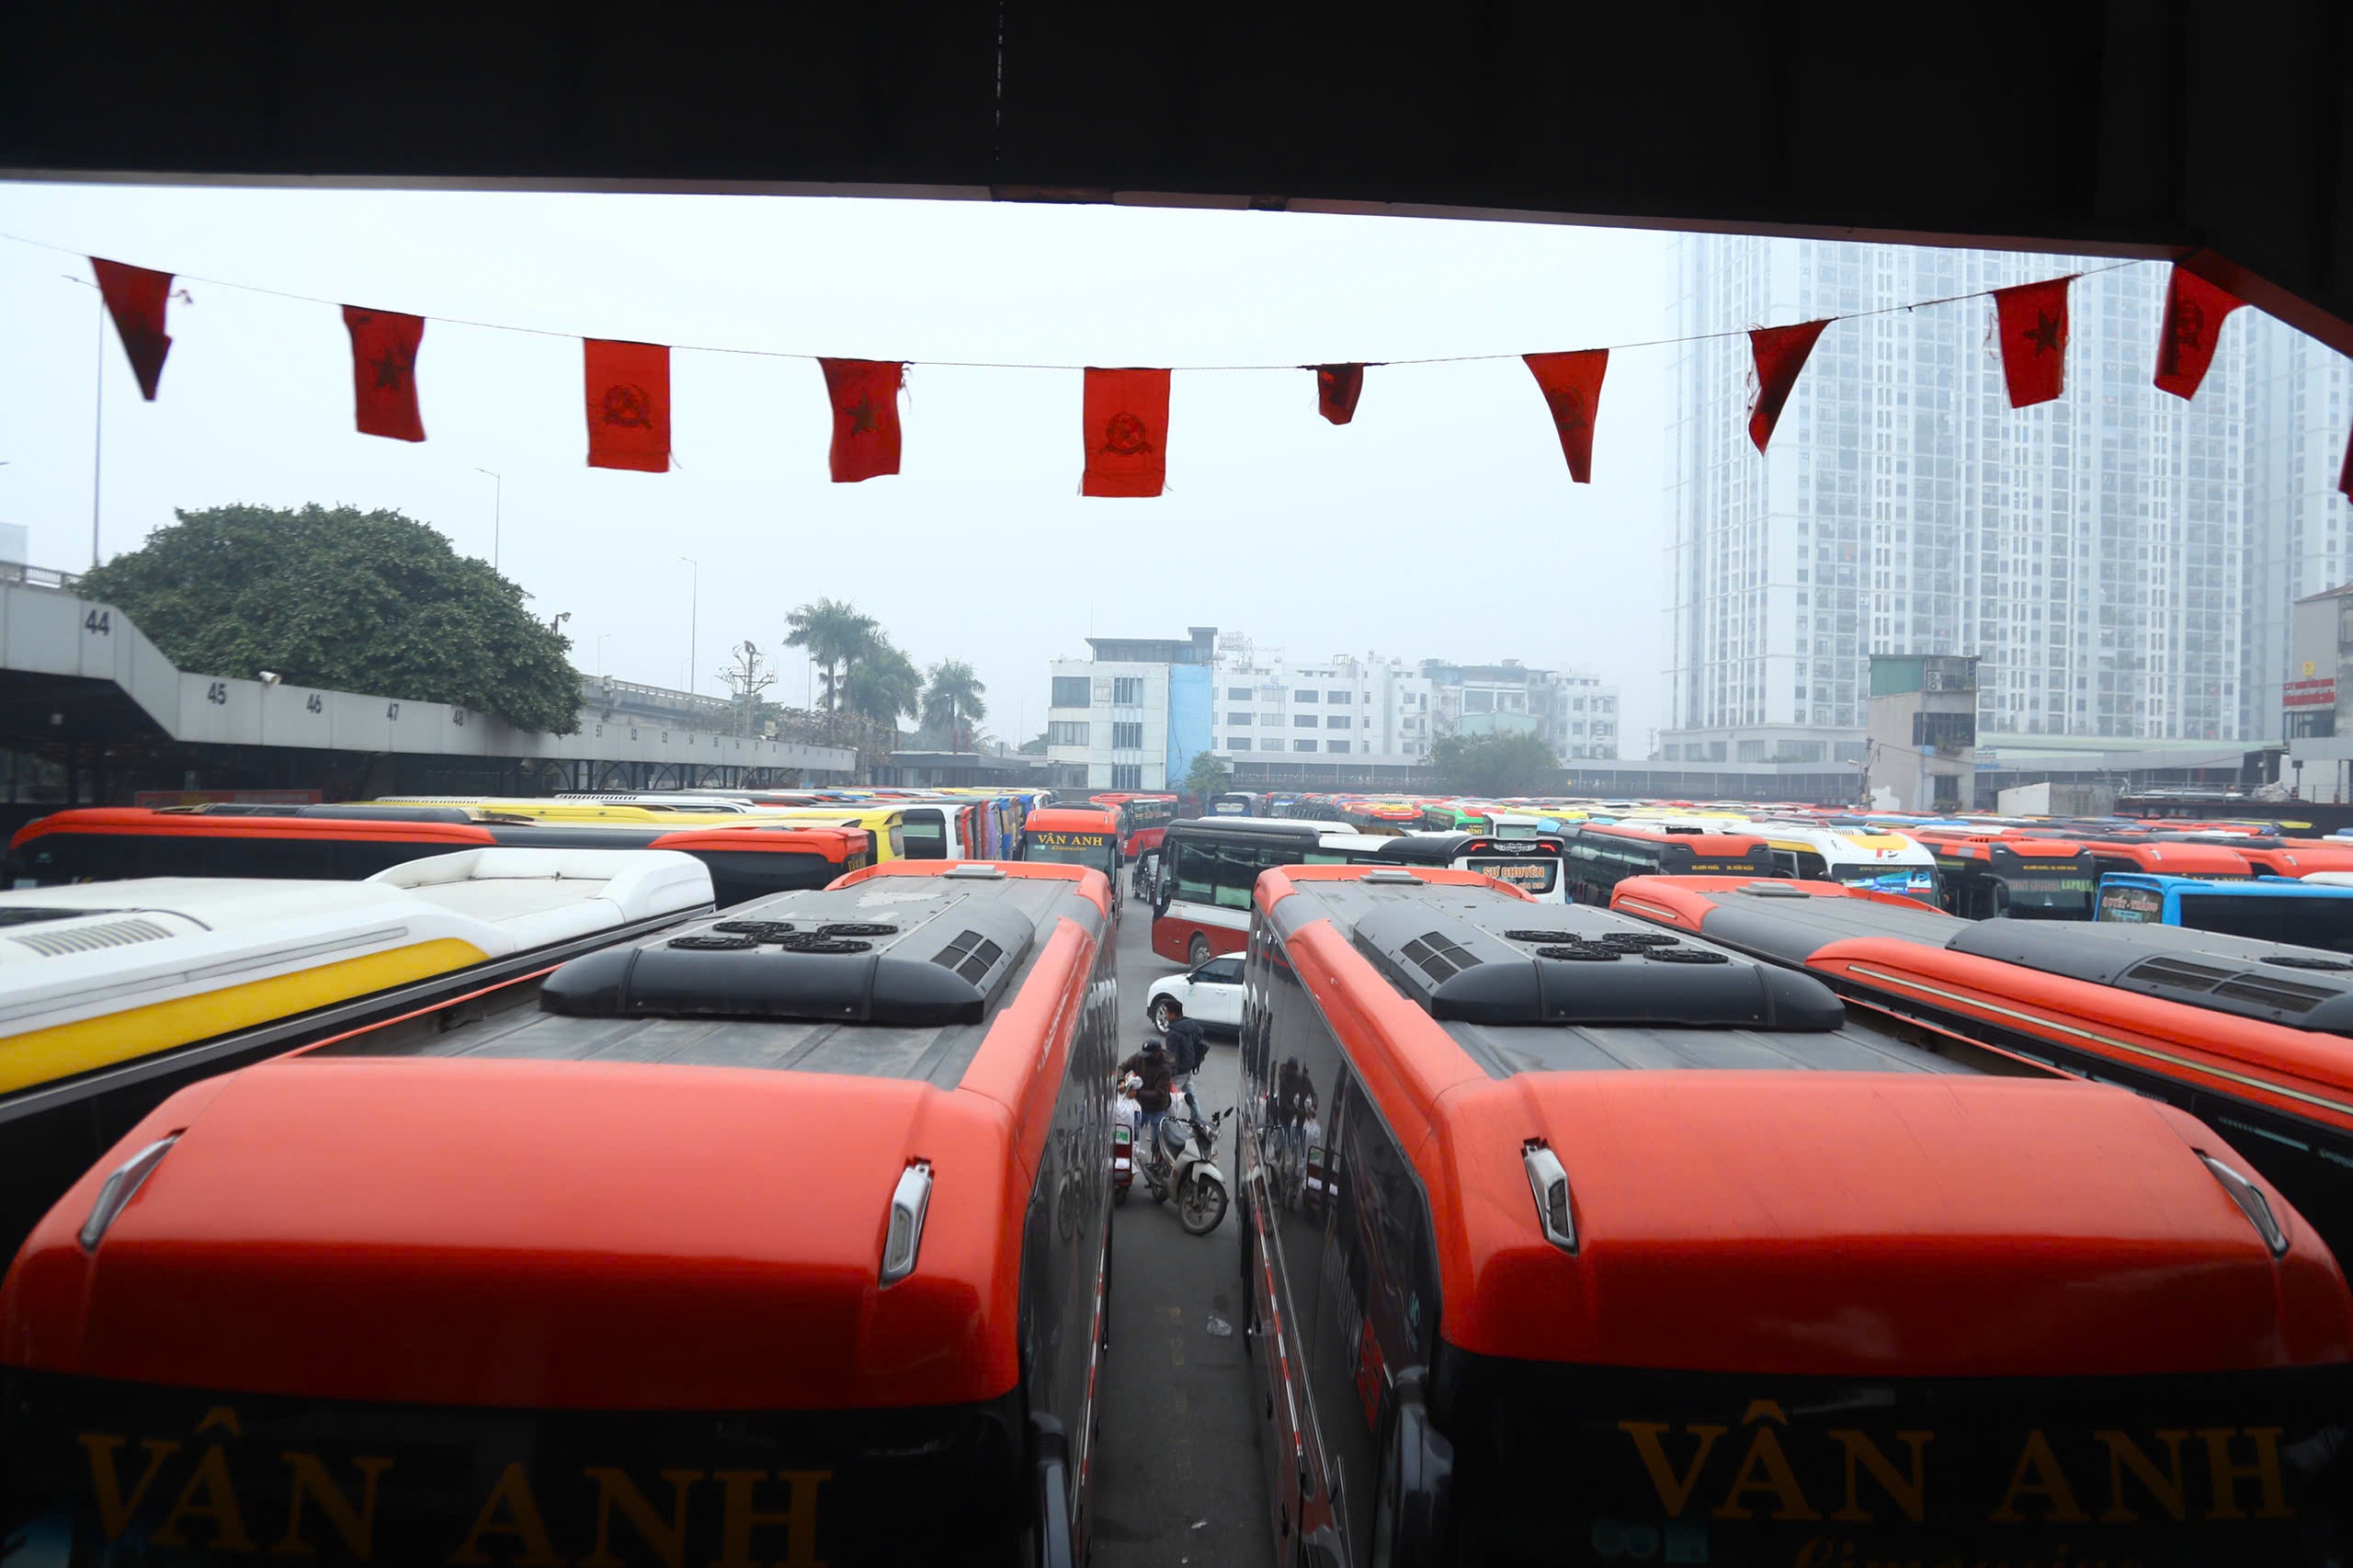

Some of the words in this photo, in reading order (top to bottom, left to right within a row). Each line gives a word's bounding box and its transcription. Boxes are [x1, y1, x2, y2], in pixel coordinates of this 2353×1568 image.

[85, 609, 109, 636] 44
[207, 682, 227, 705] 45
[306, 693, 322, 714] 46
[386, 703, 400, 722] 47
[453, 710, 463, 726] 48
[631, 728, 637, 741] 52
[1037, 833, 1066, 845] VÂN
[1071, 835, 1103, 846] ANH
[1618, 1397, 1938, 1524] VÂN
[1987, 1425, 2299, 1523] ANH
[76, 1404, 397, 1562] VÂN
[445, 1459, 835, 1568] ANH
